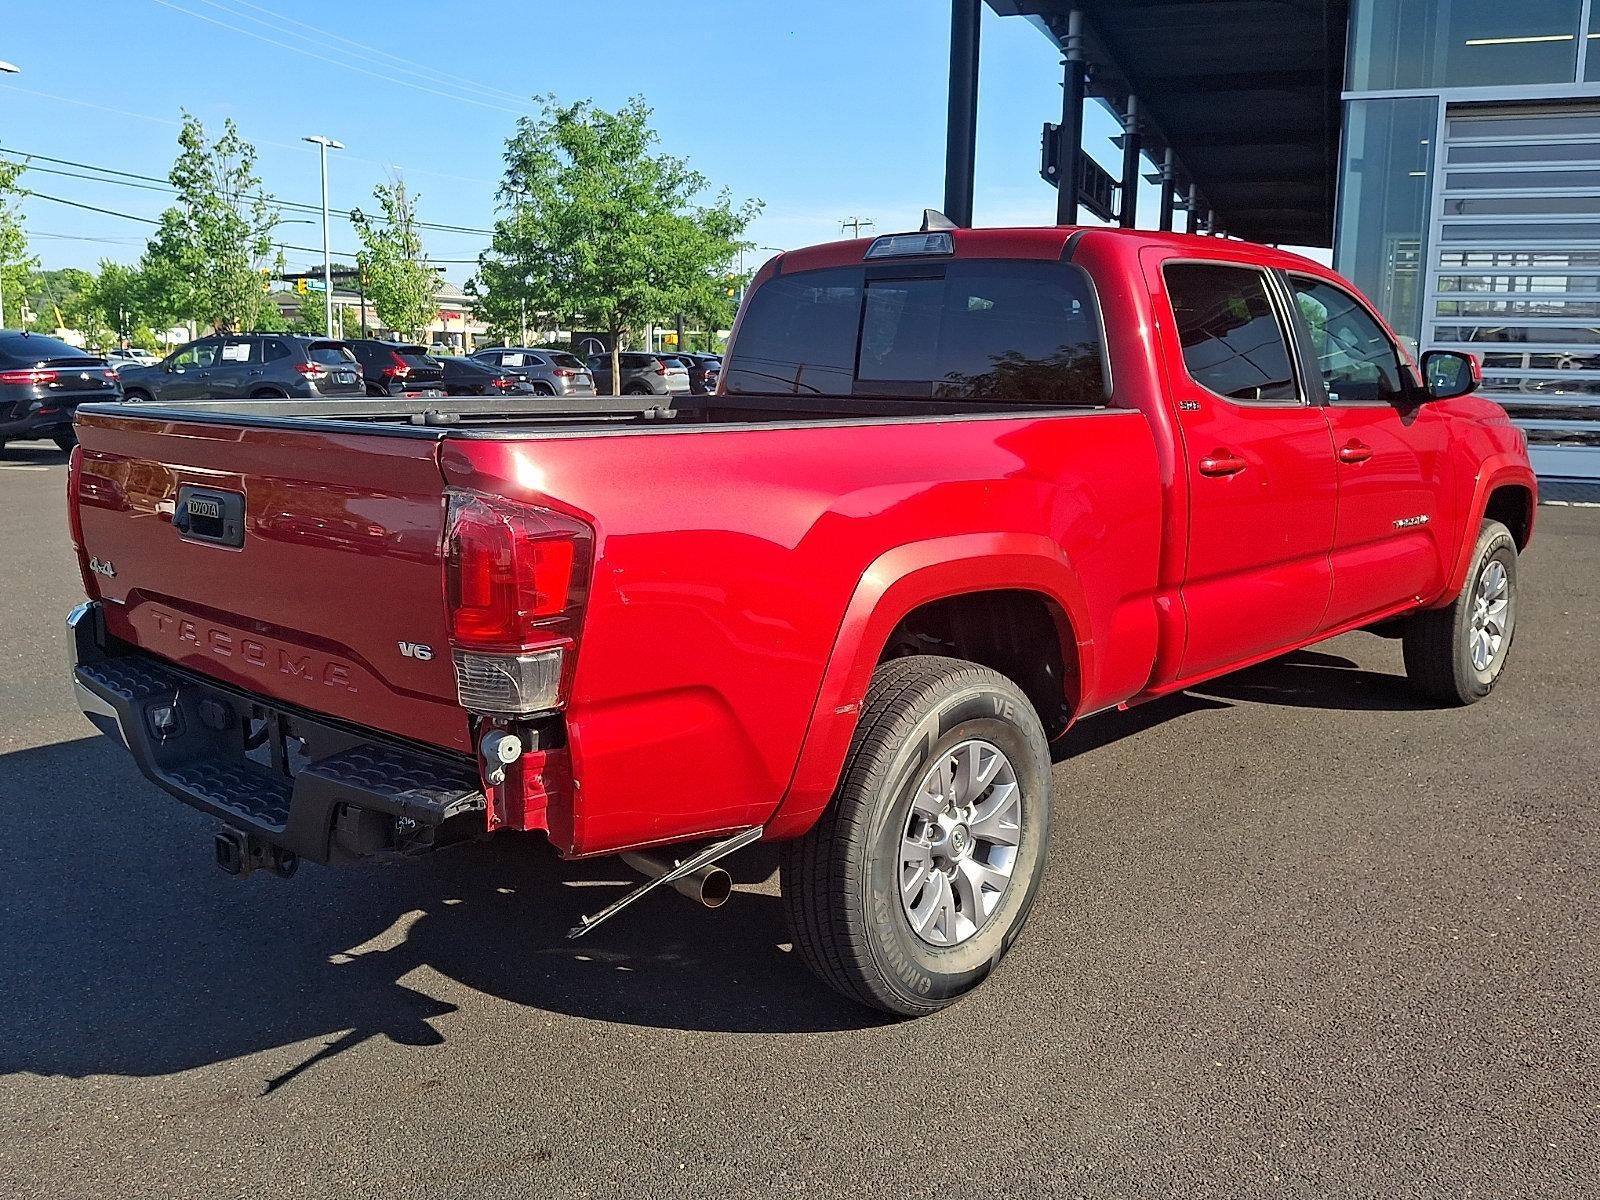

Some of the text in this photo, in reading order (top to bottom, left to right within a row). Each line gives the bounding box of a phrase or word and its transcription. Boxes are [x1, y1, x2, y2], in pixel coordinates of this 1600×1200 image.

[188, 500, 218, 517] TOYOTA
[89, 555, 116, 579] 4x4
[150, 608, 358, 693] TACOMA
[398, 641, 432, 661] V6
